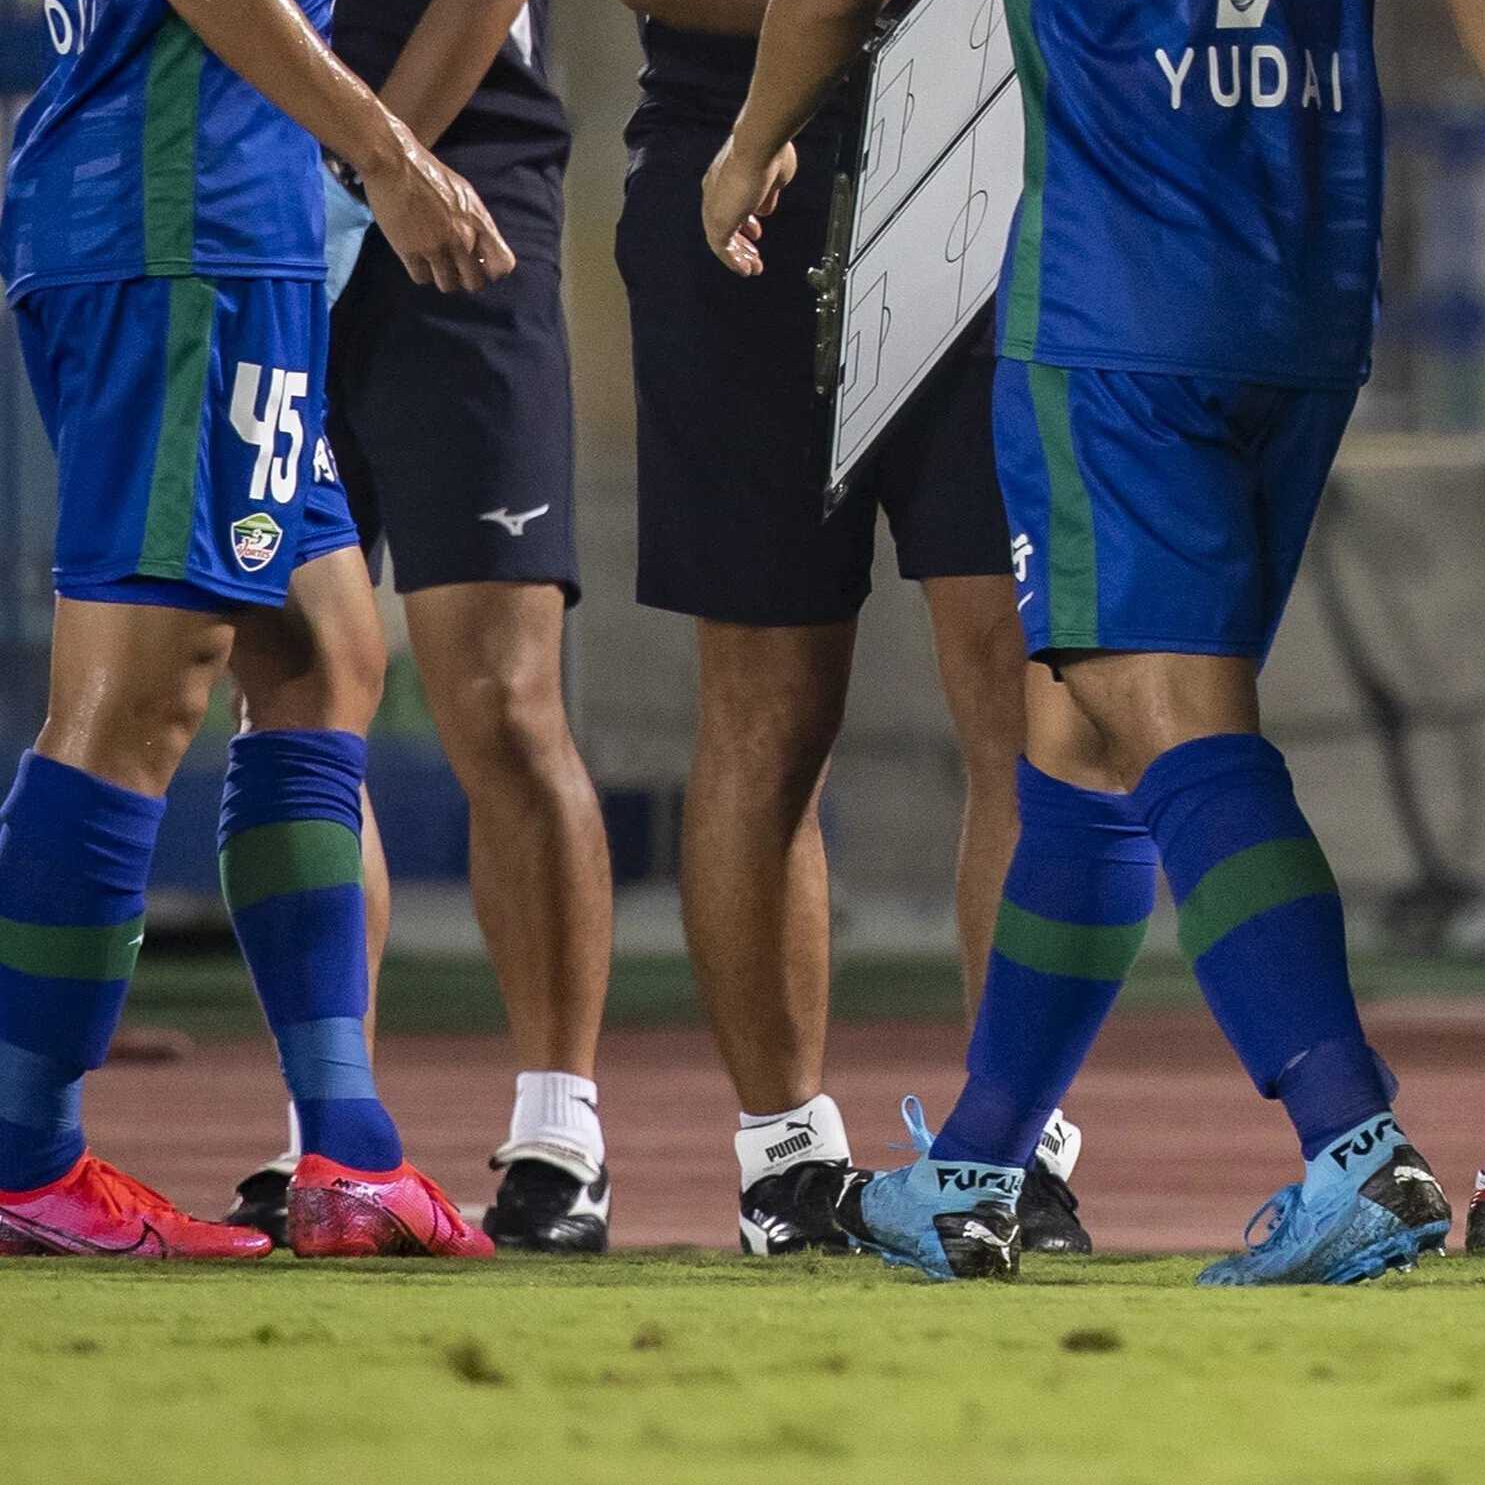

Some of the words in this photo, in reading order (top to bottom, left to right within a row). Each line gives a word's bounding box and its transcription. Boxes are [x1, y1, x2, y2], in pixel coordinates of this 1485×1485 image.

[1155, 45, 1341, 113] YUDAI
[230, 361, 308, 503] 45
[765, 1131, 812, 1163] PUMA
